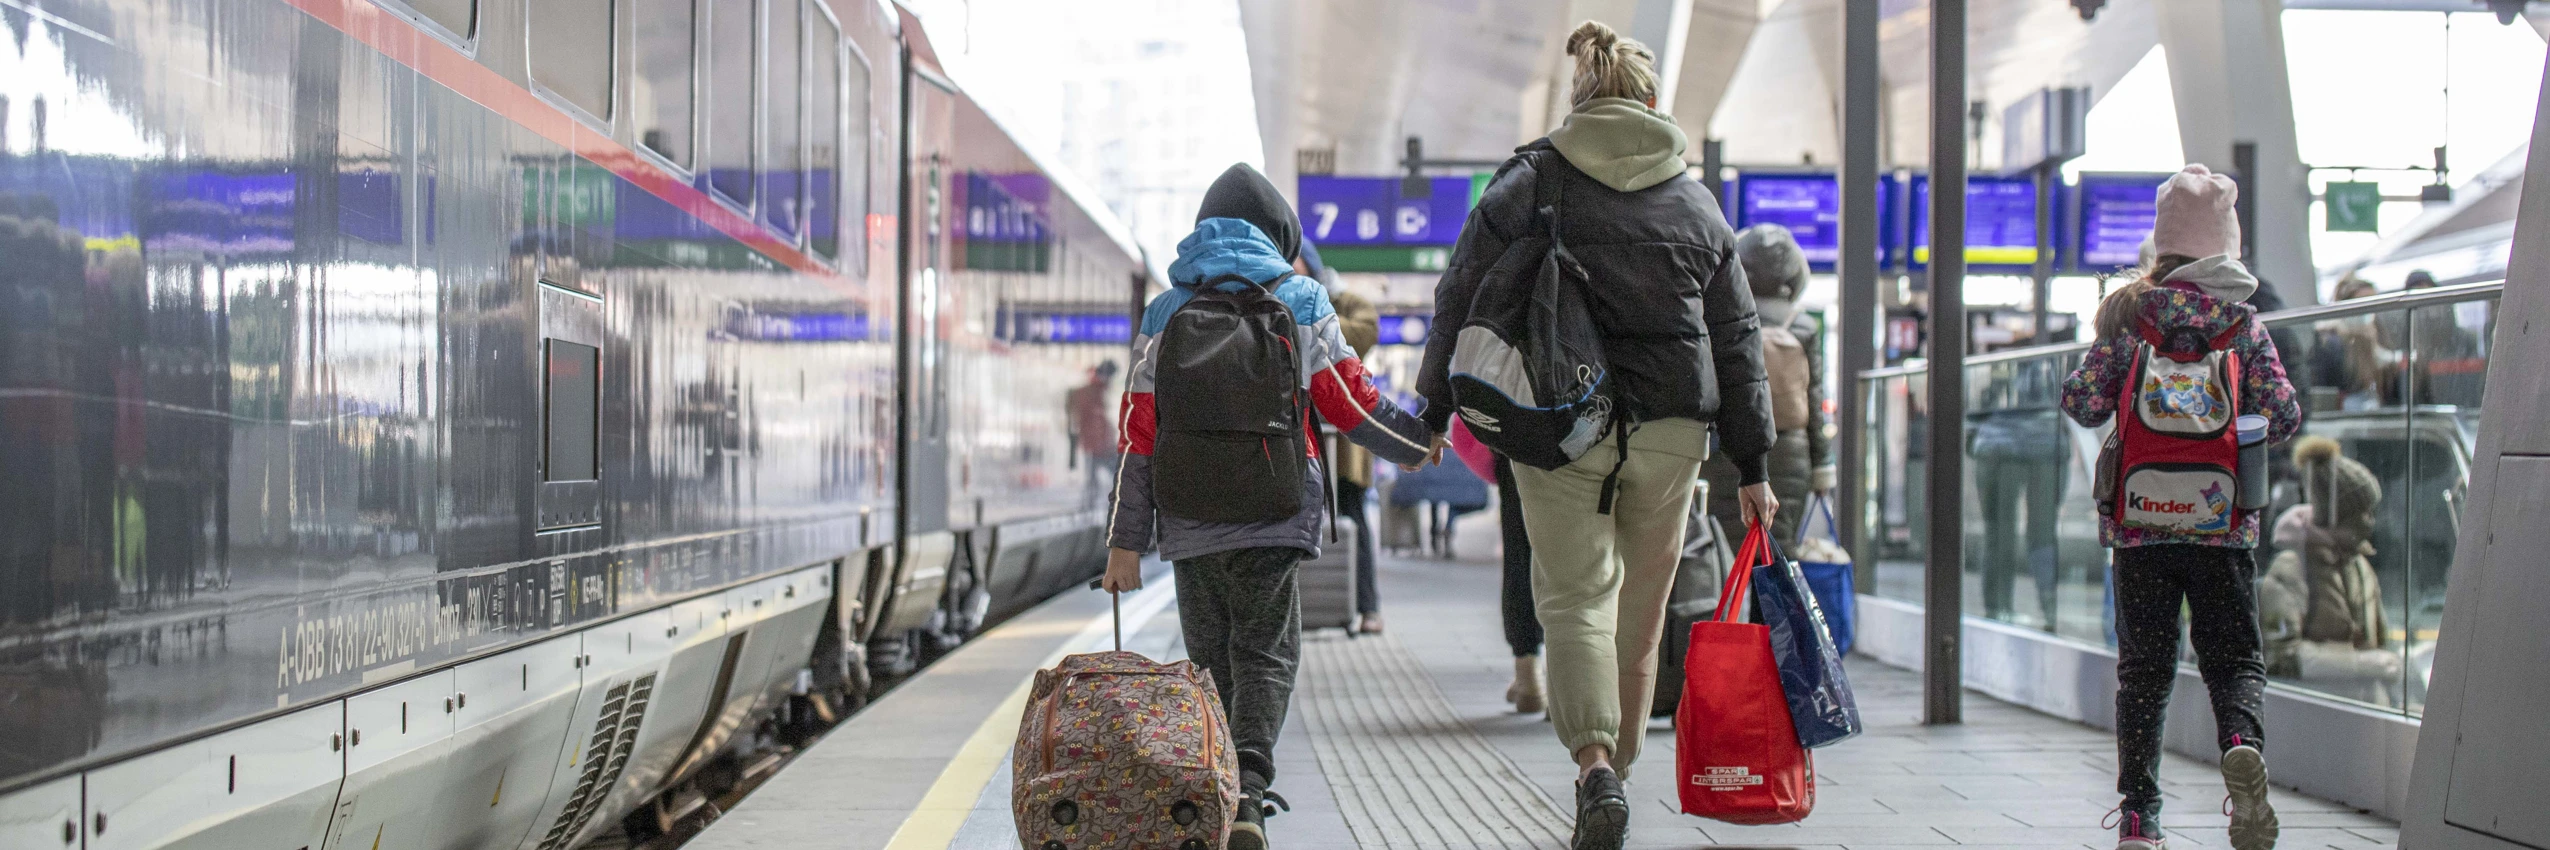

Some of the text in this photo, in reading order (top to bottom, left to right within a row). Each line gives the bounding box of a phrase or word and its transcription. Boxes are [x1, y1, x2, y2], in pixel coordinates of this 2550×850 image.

[1312, 202, 1339, 239] 7
[277, 604, 325, 689] A-ÖBB
[328, 613, 343, 675] 73
[345, 613, 360, 671] 81
[362, 605, 395, 666] 22-90
[396, 599, 426, 658] 327-6
[433, 594, 460, 654] Bmpz
